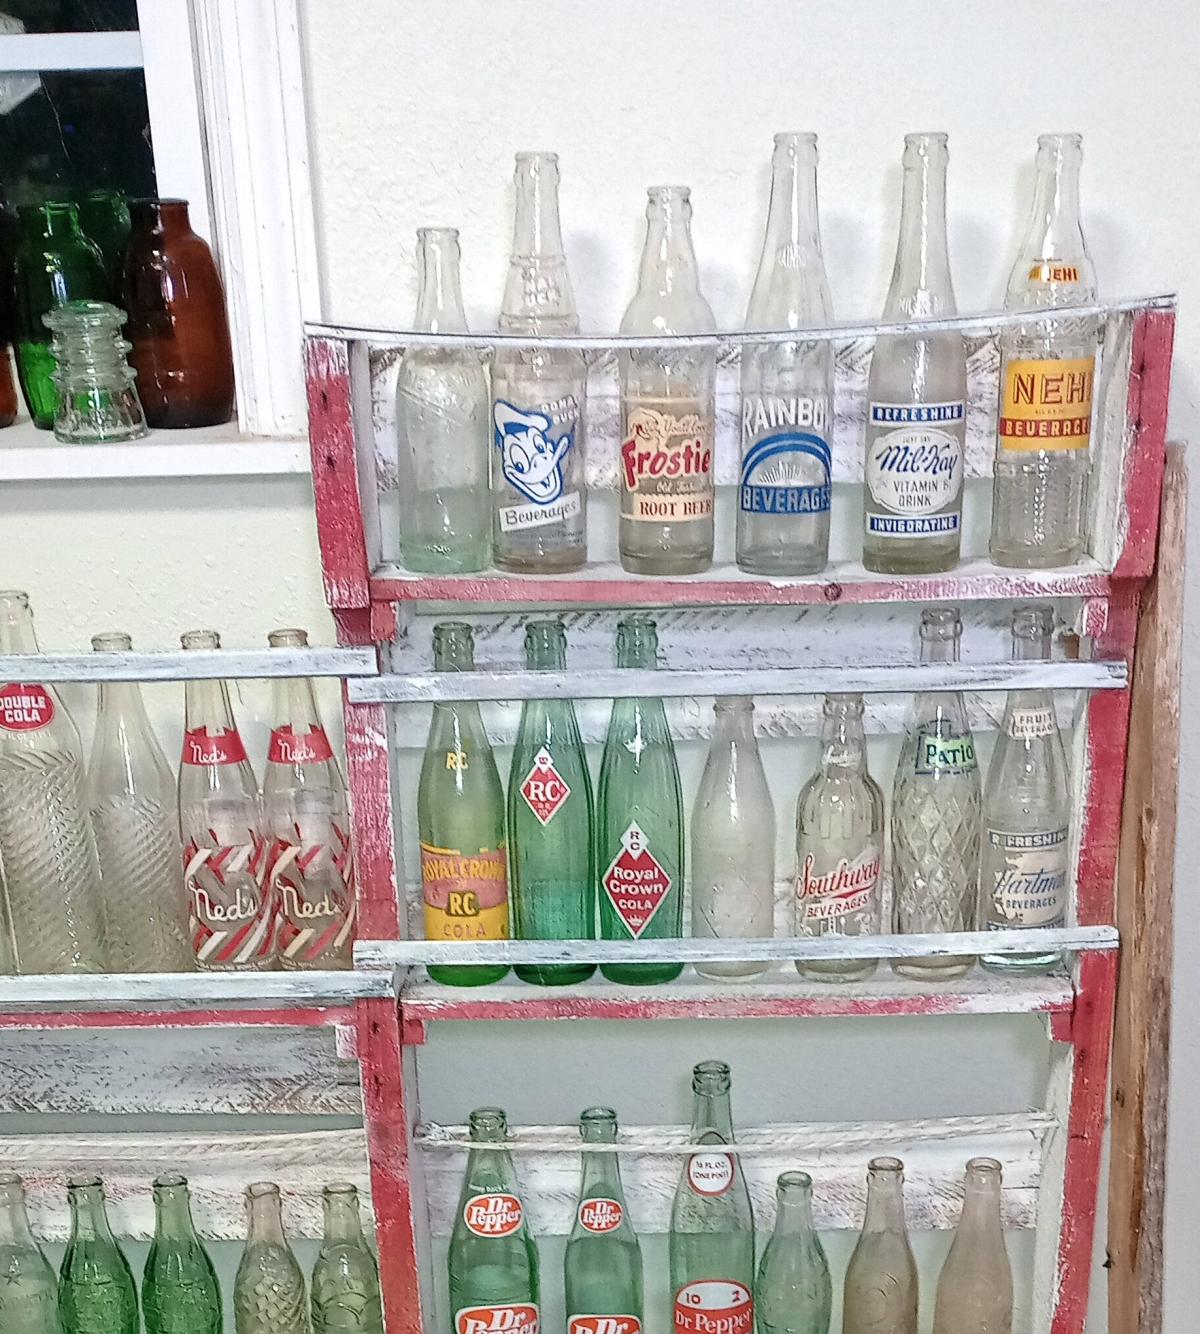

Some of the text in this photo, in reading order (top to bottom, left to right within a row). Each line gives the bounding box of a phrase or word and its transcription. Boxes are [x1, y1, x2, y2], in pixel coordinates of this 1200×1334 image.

[621, 439, 710, 488] Frostie
[893, 481, 938, 492] VITAMIN
[640, 501, 678, 516] ROOT
[898, 495, 932, 506] DRINK
[505, 500, 577, 526] Beverages
[5, 708, 41, 723] COLA
[190, 740, 227, 763] Ned's
[278, 738, 316, 762] Ned's
[445, 751, 469, 770] RC
[529, 780, 561, 802] RC
[991, 832, 1067, 848] RFRESHIN
[613, 866, 655, 884] Royal
[609, 880, 664, 895] Crown
[187, 878, 259, 921] Ned's
[449, 891, 476, 916] RC
[618, 899, 652, 911] COLA
[807, 893, 869, 918] BEVERAGES
[1006, 897, 1056, 910] BEVERAGES
[444, 923, 486, 938] COLA
[485, 1197, 513, 1214] Dr
[596, 1202, 615, 1215] Dr
[469, 1206, 521, 1233] Pepper
[582, 1208, 622, 1230] Pepper
[685, 1292, 701, 1305] 10
[487, 1309, 527, 1331] Dr
[675, 1310, 693, 1330] Dr
